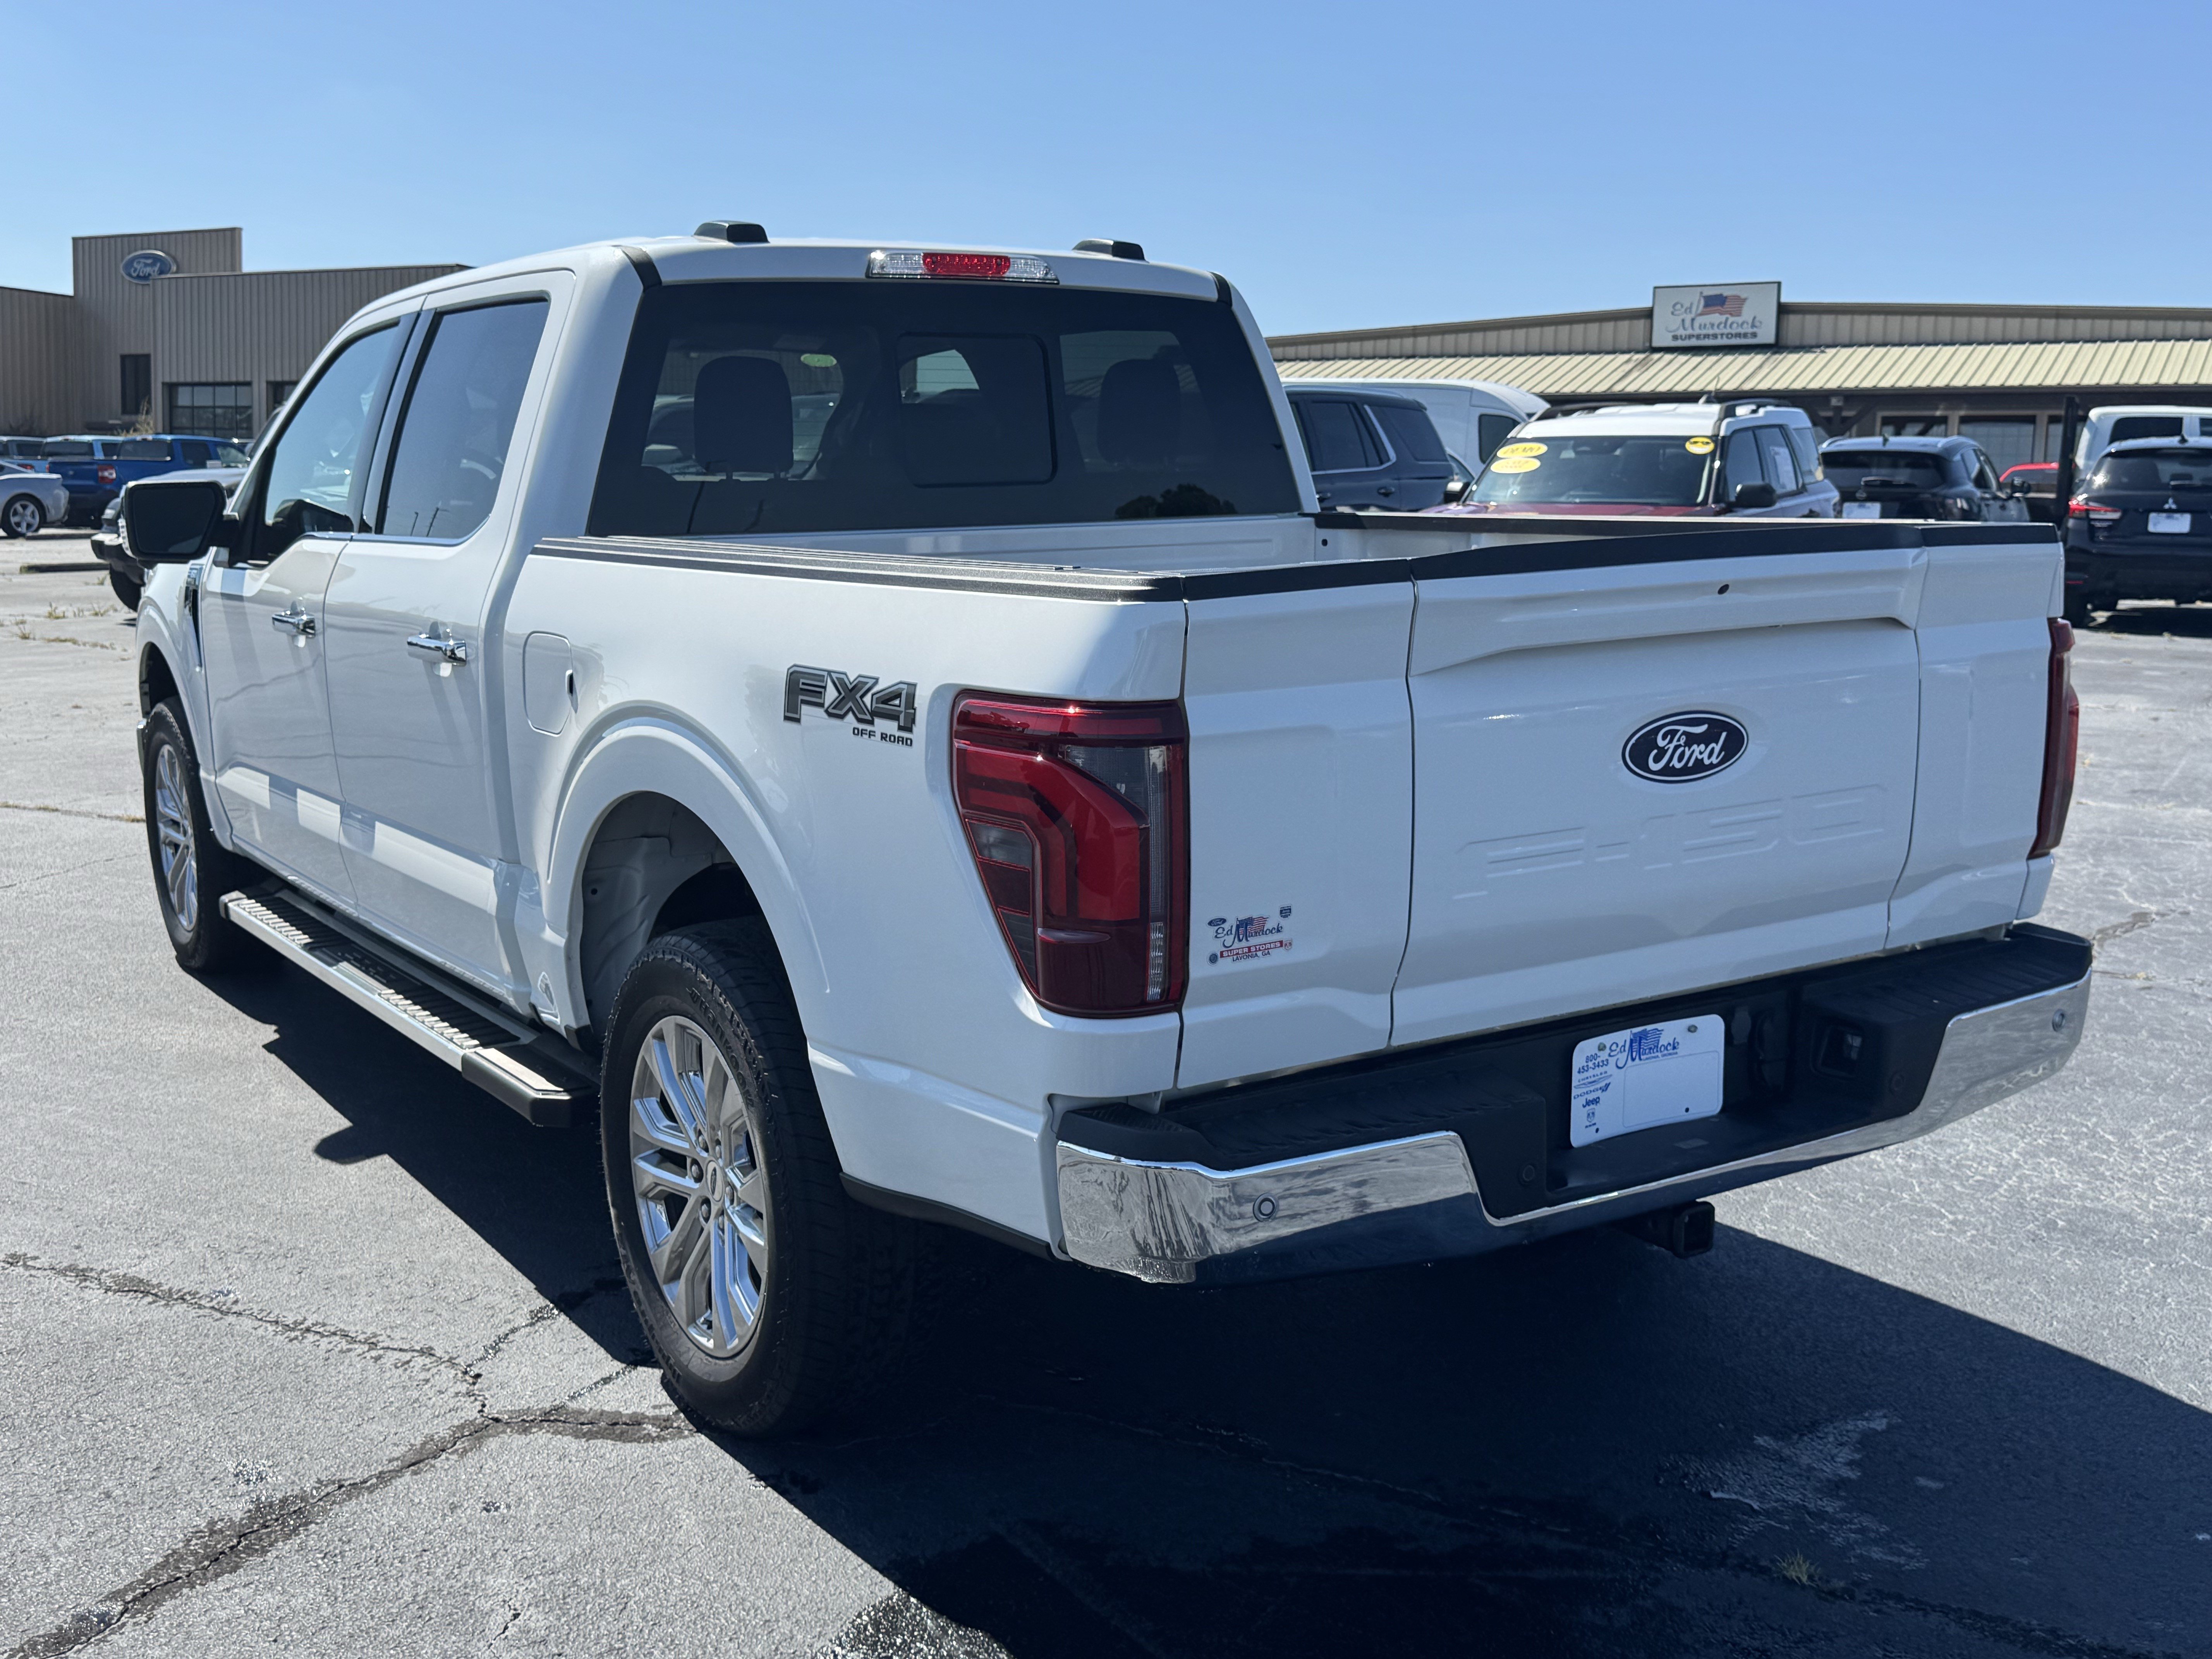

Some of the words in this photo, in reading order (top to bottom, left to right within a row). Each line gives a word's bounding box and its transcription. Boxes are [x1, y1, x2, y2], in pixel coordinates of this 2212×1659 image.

[131, 258, 160, 277] Ford
[1671, 301, 1693, 317] Ed
[1665, 316, 1763, 333] Murdock
[1671, 331, 1758, 342] SUPERSTORES
[783, 663, 918, 735] FX4
[852, 727, 876, 738] OFF
[880, 732, 913, 747] ROAD
[1648, 724, 1727, 771] Ford
[1214, 925, 1233, 939] Ed
[1222, 922, 1283, 948] Murdock
[1223, 947, 1248, 957] SUPER
[1250, 941, 1281, 951] STORES
[1608, 1039, 1626, 1057] Ed
[1616, 1035, 1680, 1069] Murdock
[1585, 1053, 1601, 1063] 800-
[1582, 1096, 1600, 1108] Jeep
